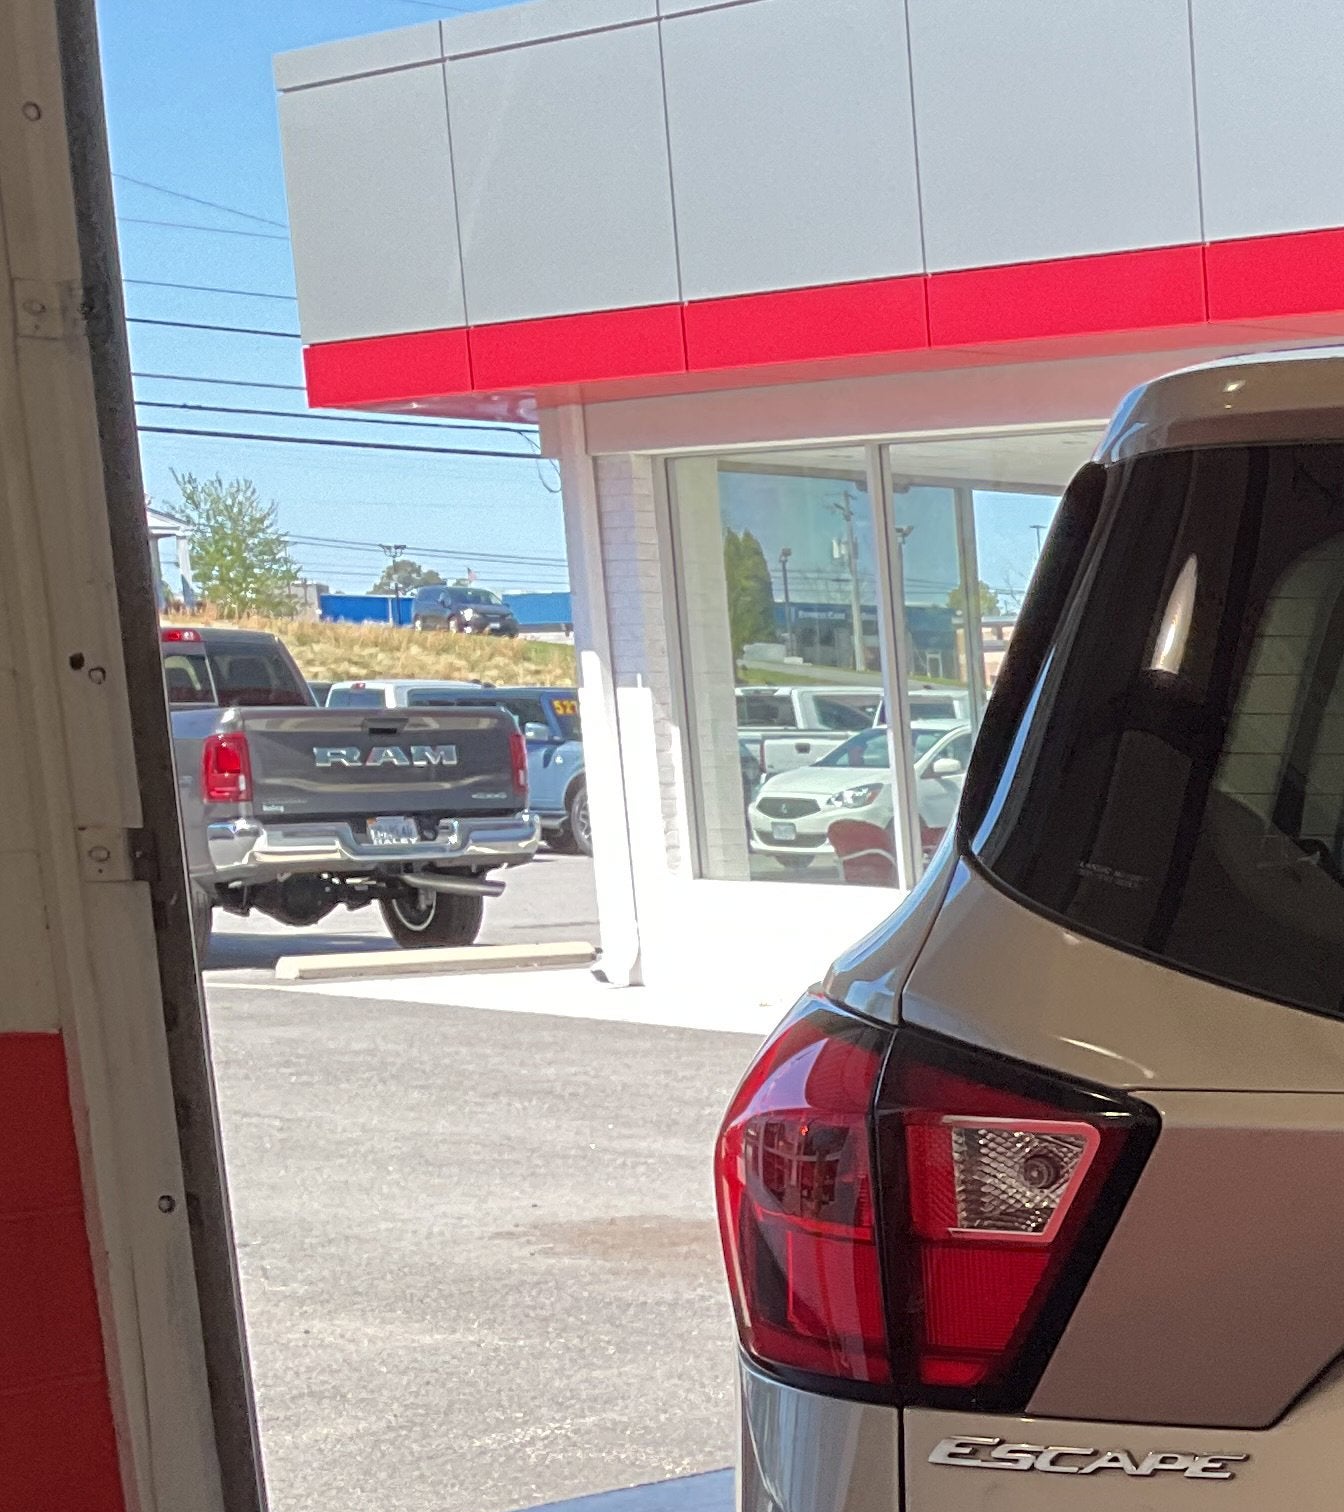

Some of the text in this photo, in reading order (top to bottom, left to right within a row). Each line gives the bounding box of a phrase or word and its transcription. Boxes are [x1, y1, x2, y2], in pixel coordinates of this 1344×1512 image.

[313, 745, 458, 767] RAM
[373, 837, 418, 846] HALEY
[928, 1436, 1248, 1479] ESCAPE
